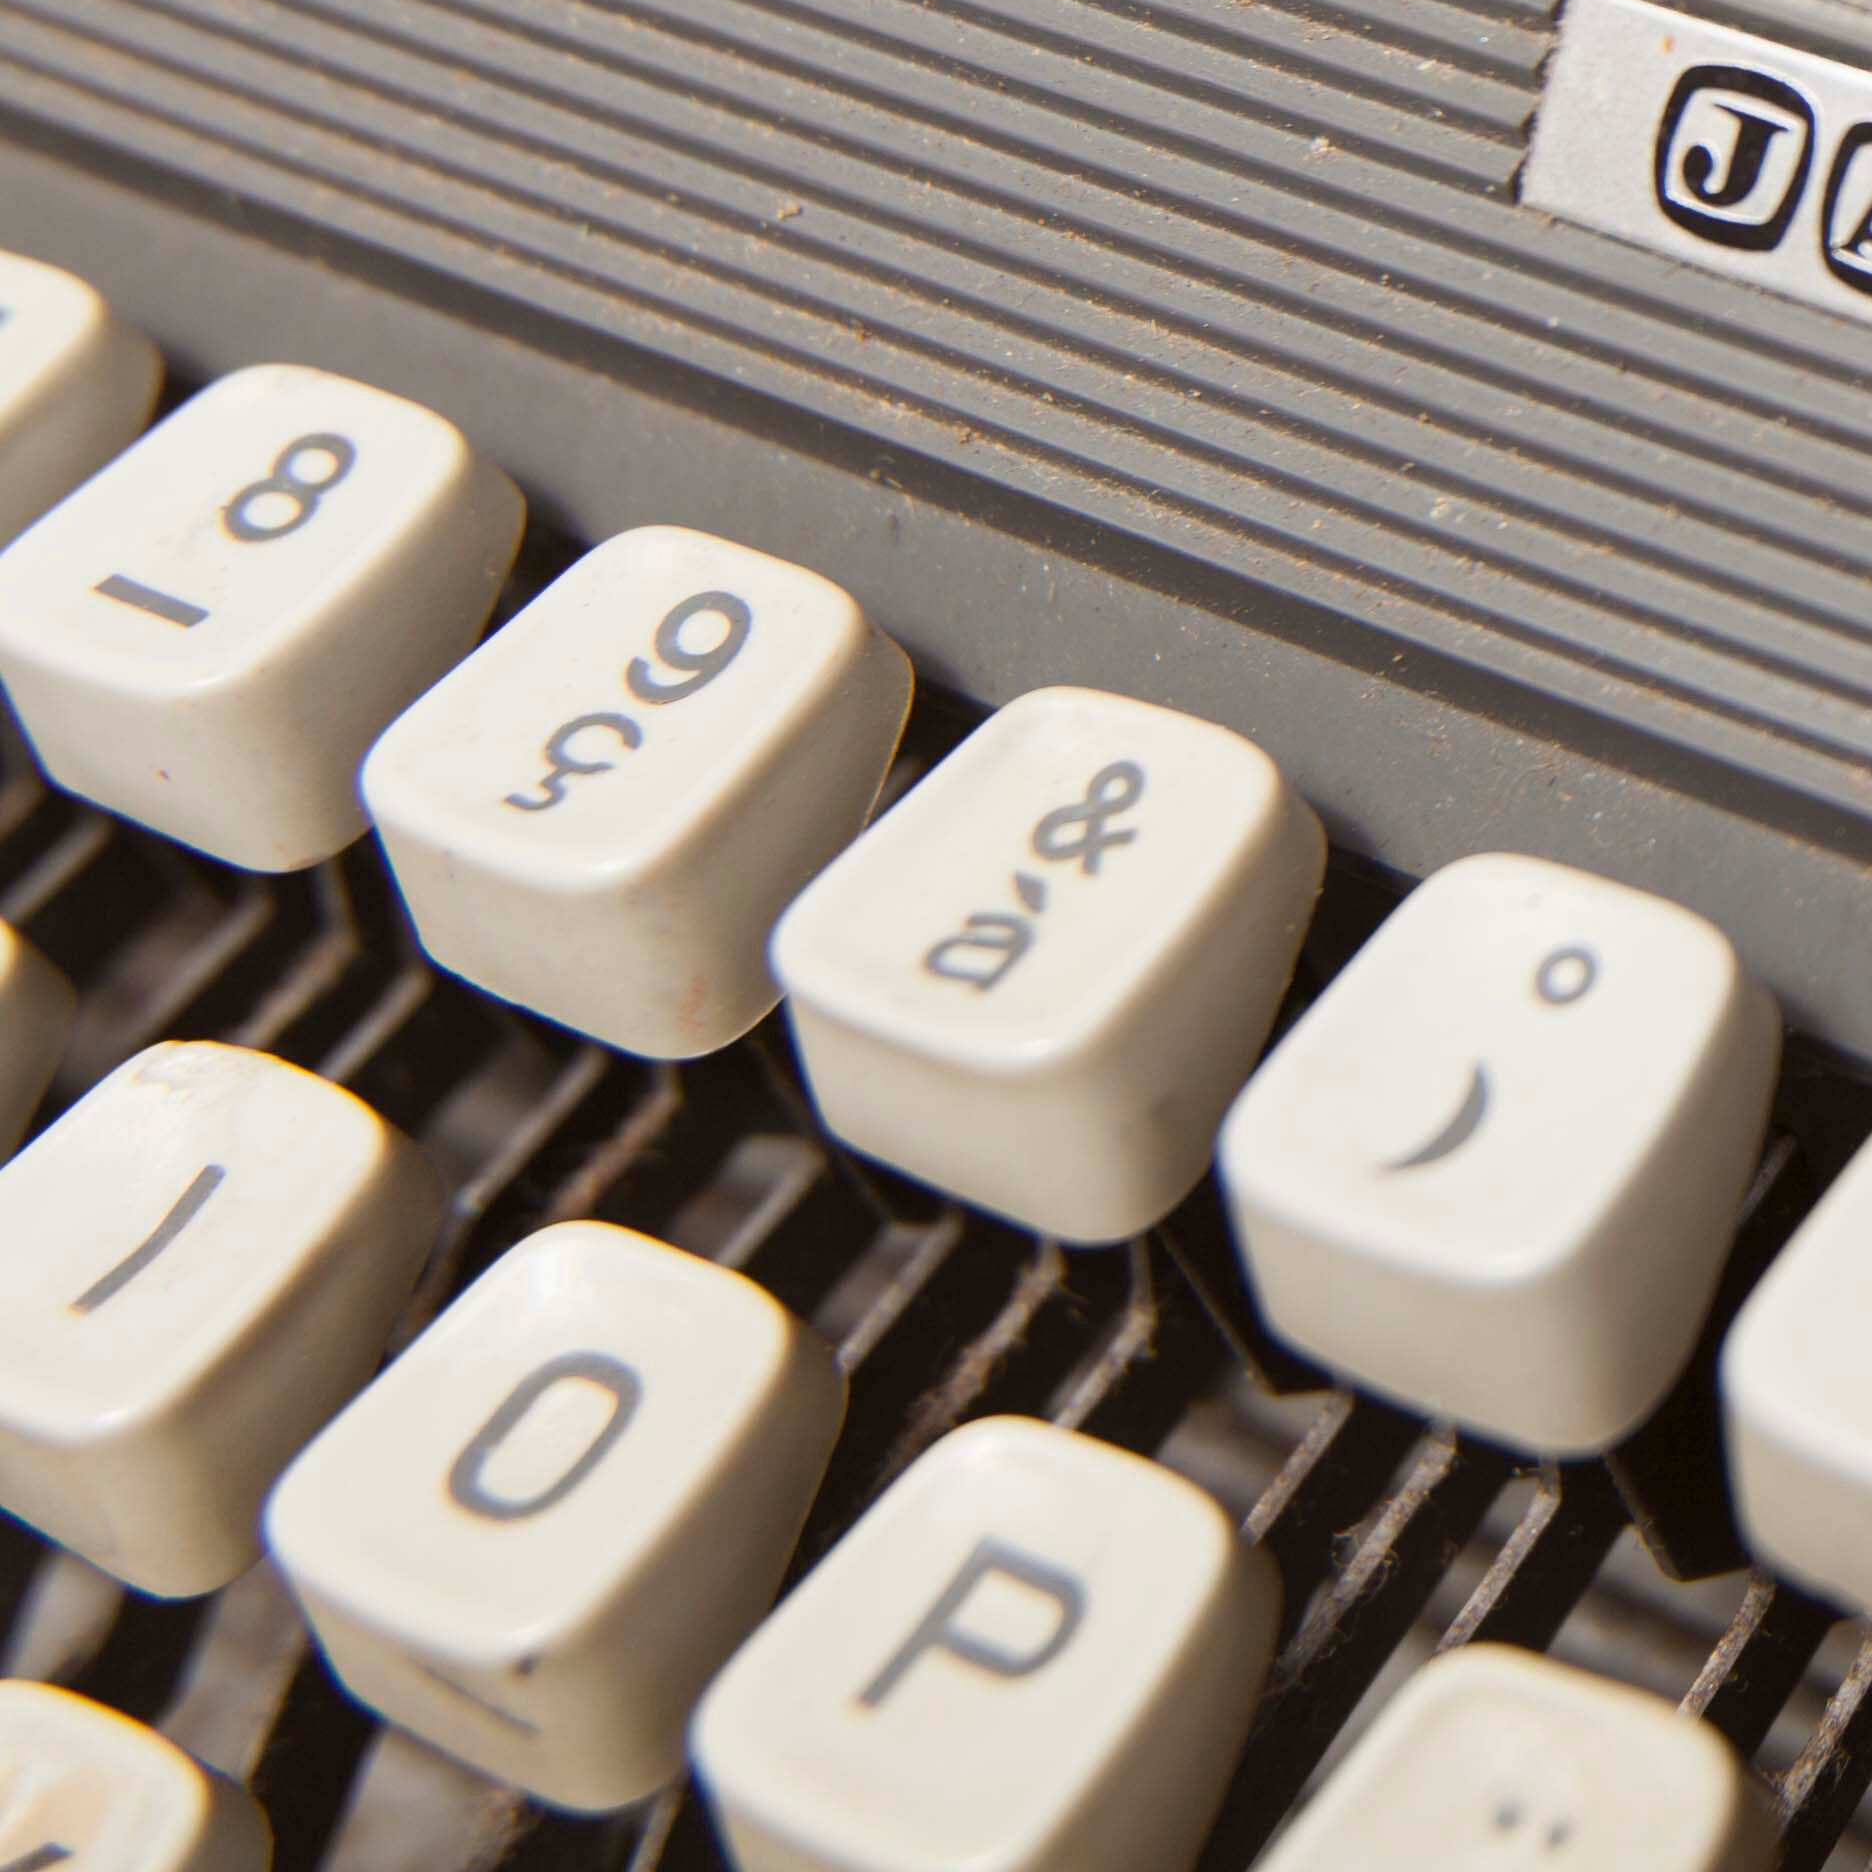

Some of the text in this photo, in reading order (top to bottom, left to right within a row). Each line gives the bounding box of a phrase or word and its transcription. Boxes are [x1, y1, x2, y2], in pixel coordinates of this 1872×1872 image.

[220, 431, 358, 544] 8
[626, 590, 753, 705] 9
[1032, 760, 1146, 876] &
[445, 1352, 644, 1525] O
[856, 1537, 1088, 1711] P
